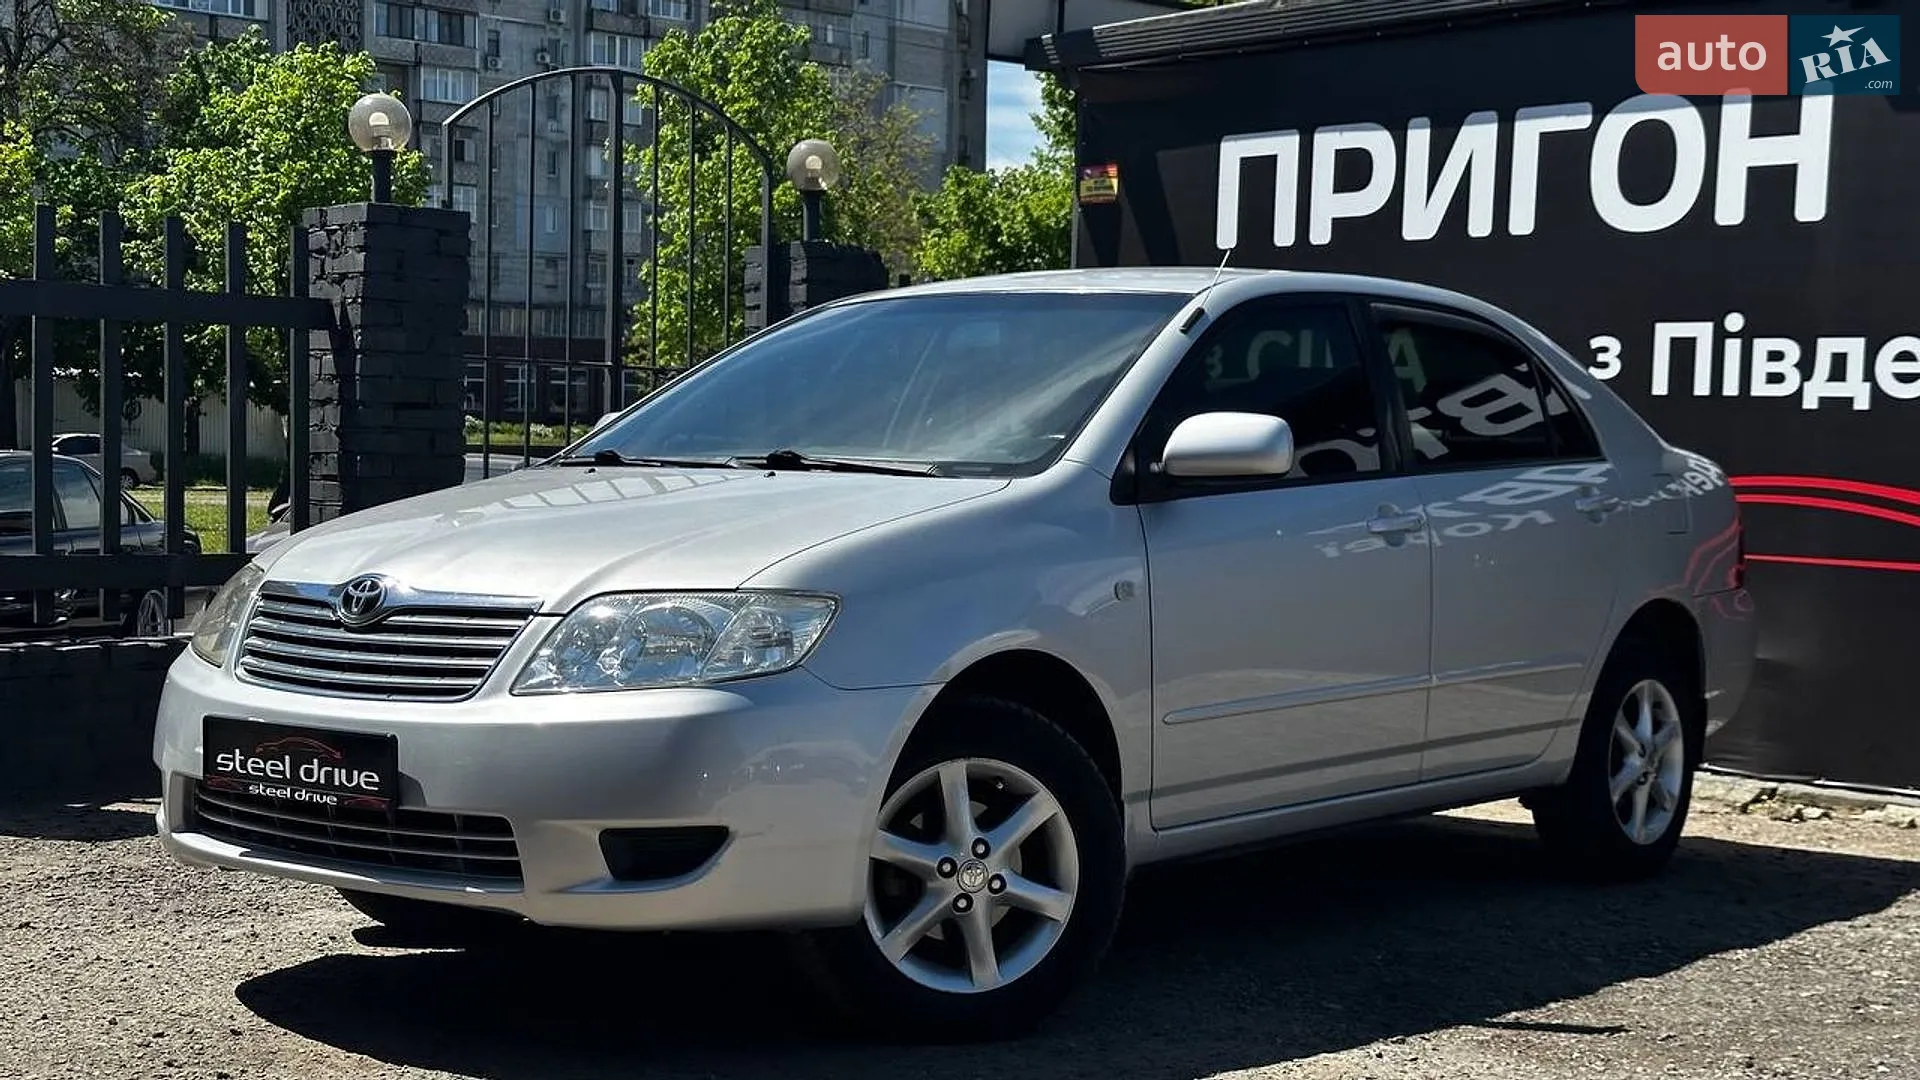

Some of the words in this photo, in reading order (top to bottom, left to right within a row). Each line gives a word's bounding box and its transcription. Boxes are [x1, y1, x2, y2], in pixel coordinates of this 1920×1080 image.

[1217, 82, 1834, 250] ПРИГОН
[1587, 335, 1622, 381] з
[216, 749, 290, 779] steel
[299, 758, 380, 791] drive
[248, 783, 290, 799] steel
[294, 789, 338, 806] drive
